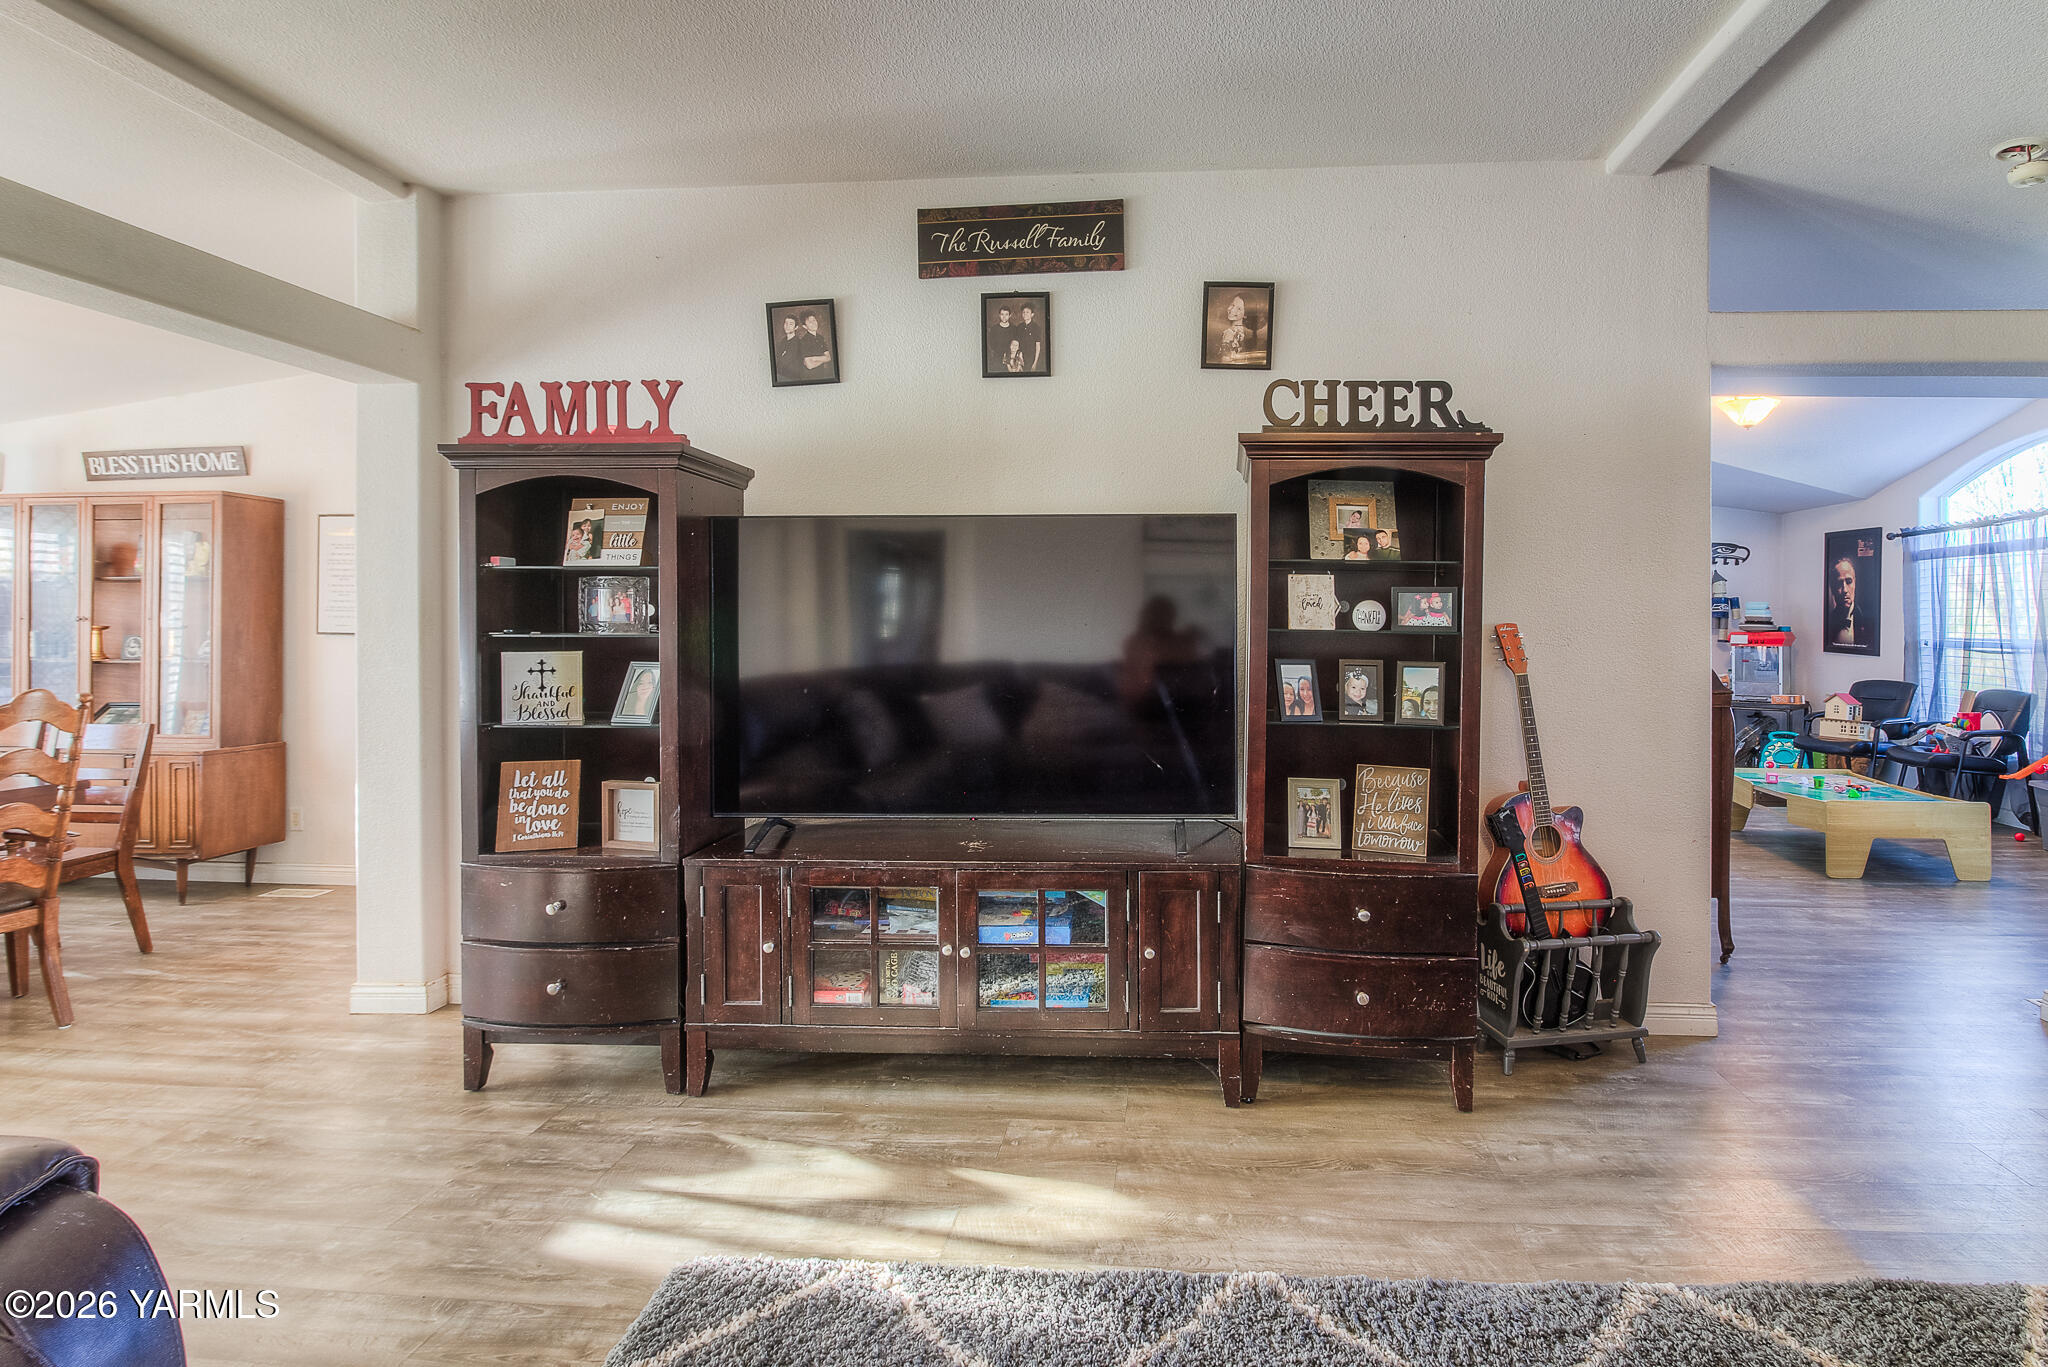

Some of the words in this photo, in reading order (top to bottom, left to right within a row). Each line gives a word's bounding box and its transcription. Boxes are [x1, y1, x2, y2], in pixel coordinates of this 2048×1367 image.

[931, 227, 967, 253] The
[967, 223, 1049, 254] Russell
[1045, 220, 1106, 250] Family
[464, 379, 684, 438] FAMILY
[1262, 378, 1486, 428] CHEER
[87, 455, 139, 476] BLESS
[139, 453, 178, 474] THIS
[179, 451, 240, 473] HOME
[611, 503, 645, 511] ENJOY
[609, 532, 638, 548] little
[605, 553, 638, 561] THINGS
[512, 680, 576, 702] Thankful
[513, 701, 571, 722] Blessed
[536, 700, 556, 708] AND
[513, 769, 539, 788] Let
[541, 769, 569, 788] all
[1358, 767, 1426, 793] Because
[508, 788, 534, 800] that
[533, 788, 555, 801] you
[554, 786, 571, 799] do
[1357, 791, 1387, 818] He
[1387, 786, 1423, 814] lives
[509, 798, 528, 814] be
[526, 800, 570, 818] done
[514, 813, 527, 825] in
[525, 816, 562, 834] love
[1377, 815, 1401, 830] can
[1399, 813, 1425, 835] face
[1356, 822, 1425, 852] tomorrow
[1480, 942, 1506, 980] Life
